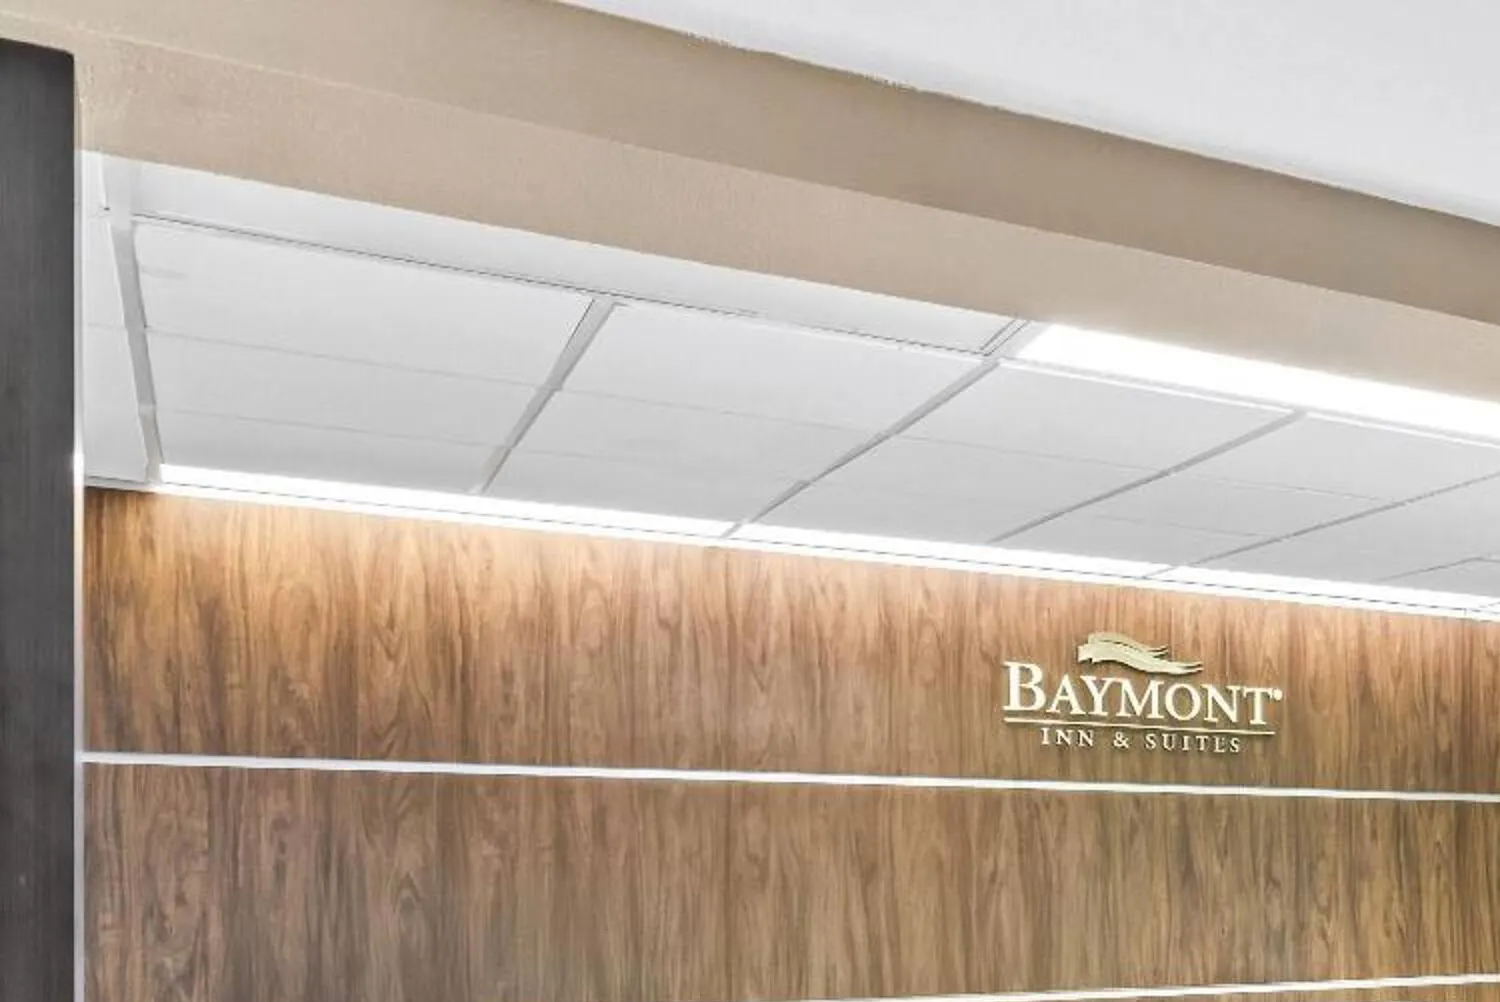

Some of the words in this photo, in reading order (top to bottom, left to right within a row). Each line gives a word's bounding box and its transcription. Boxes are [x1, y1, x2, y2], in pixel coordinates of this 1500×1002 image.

[1041, 727, 1094, 747] INN
[1113, 731, 1130, 748] &
[1145, 733, 1241, 753] SUITES
